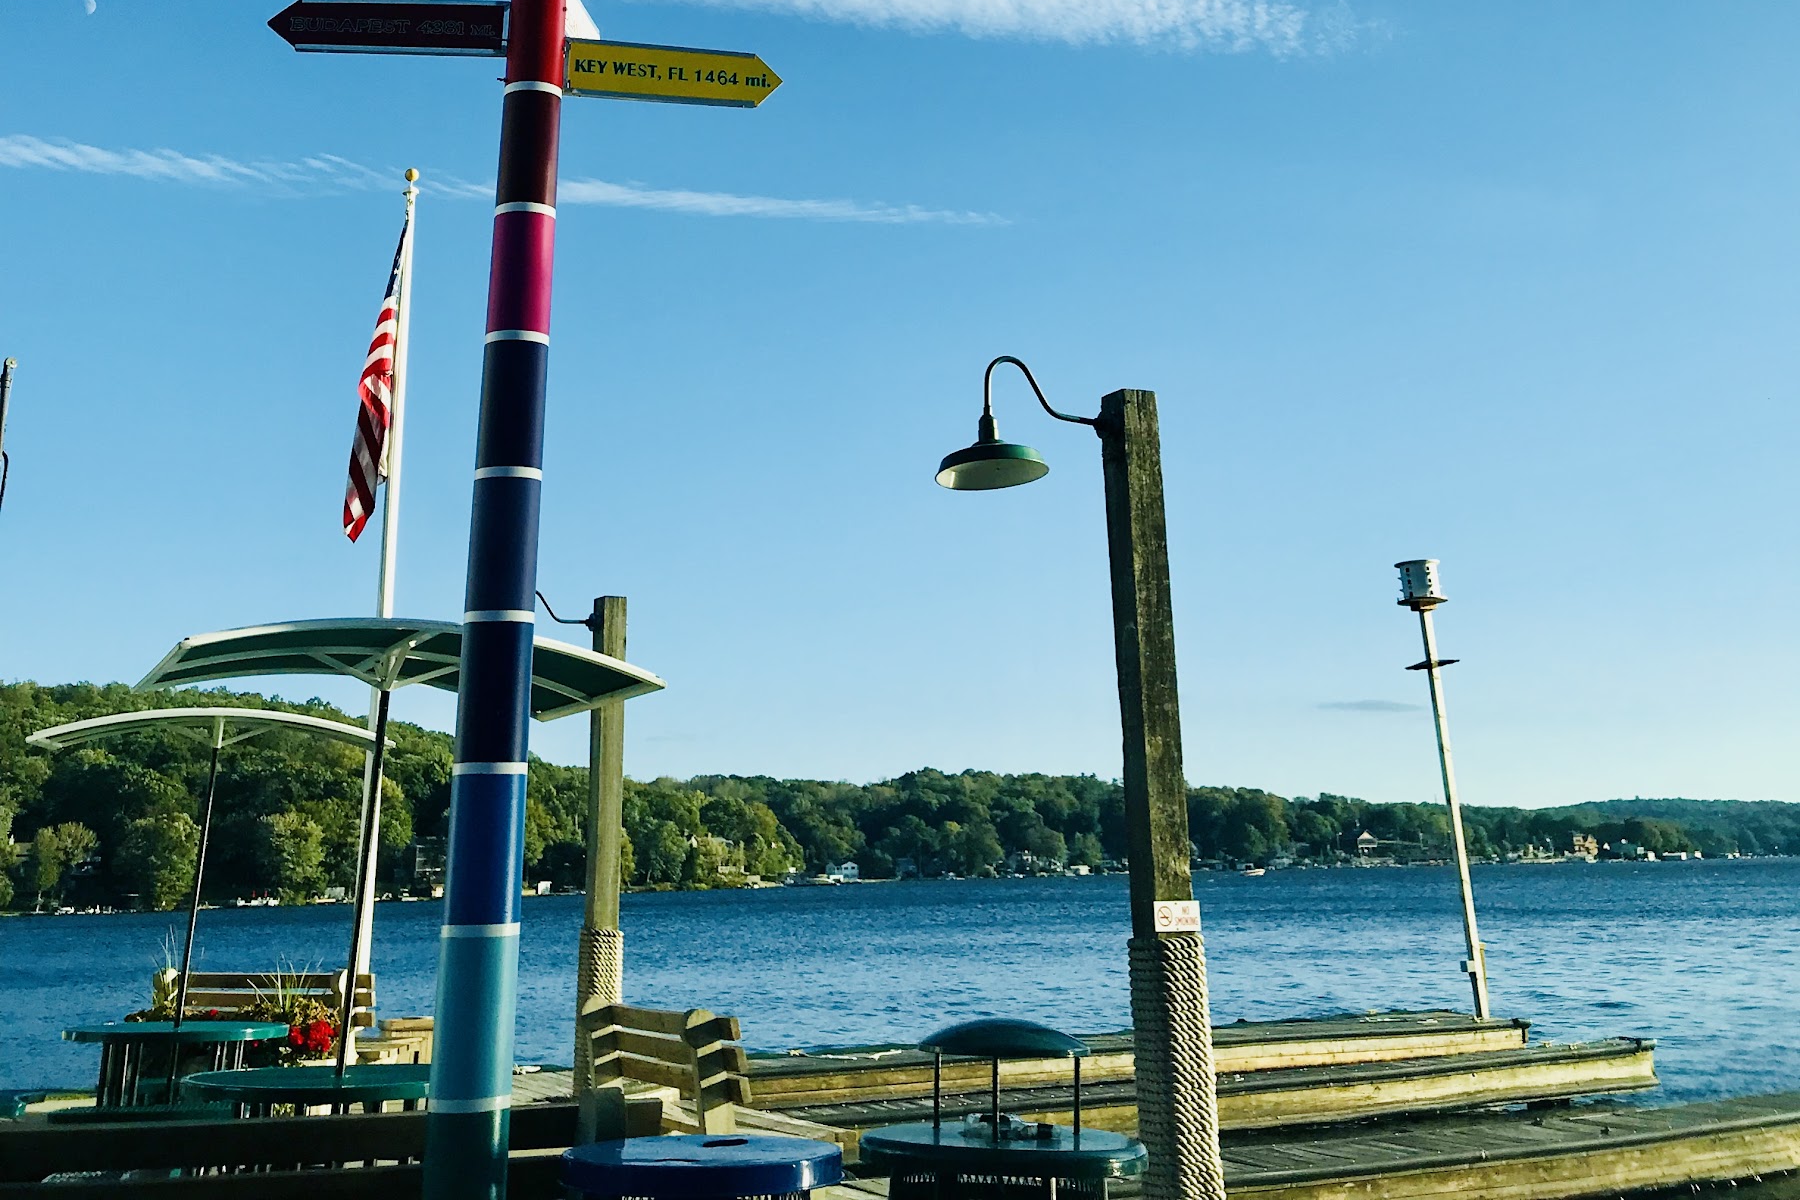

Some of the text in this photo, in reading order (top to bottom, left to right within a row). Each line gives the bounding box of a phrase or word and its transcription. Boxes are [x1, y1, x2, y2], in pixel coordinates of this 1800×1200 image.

[289, 16, 411, 35] BUDAPEST
[416, 19, 466, 36] 4381
[574, 58, 772, 89] KEY WEST, FL 1464 mi.
